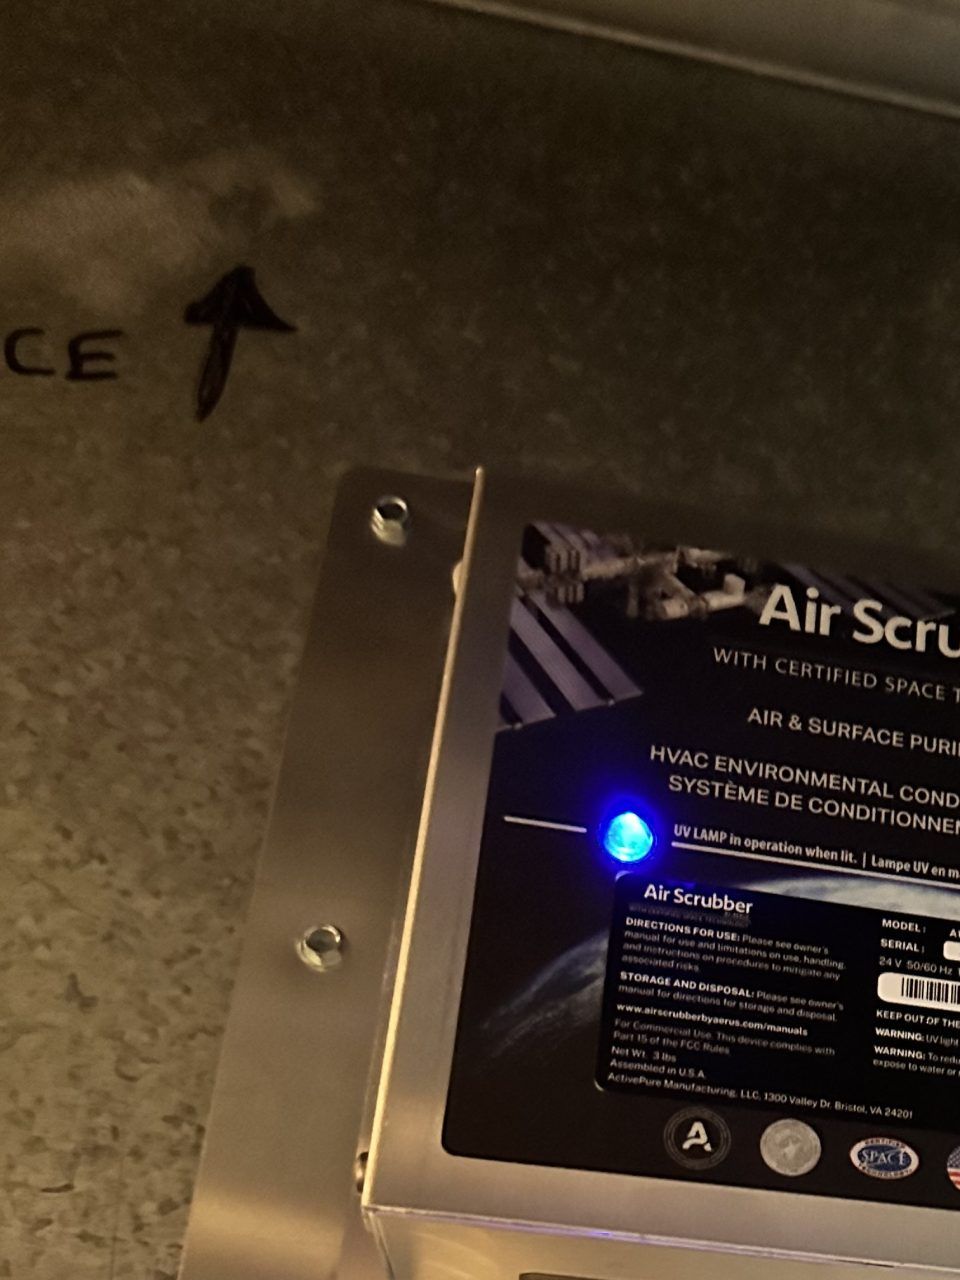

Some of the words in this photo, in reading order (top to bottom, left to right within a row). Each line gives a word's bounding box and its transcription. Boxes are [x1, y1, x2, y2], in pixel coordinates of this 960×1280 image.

[759, 585, 842, 636] Air
[712, 646, 767, 670] WITH
[774, 657, 877, 689] CERTIFIED
[884, 676, 945, 701] SPACE
[746, 706, 783, 727] AIR
[787, 713, 802, 731] &
[807, 716, 904, 748] SURFACE
[649, 744, 709, 769] HVAC
[713, 754, 894, 799] ENVIRONMENTAL
[668, 771, 770, 805] SYSTÈME
[774, 790, 803, 810] DE
[673, 823, 691, 838] UV
[692, 826, 727, 844] LAMP
[728, 832, 742, 846] in
[742, 834, 803, 858] operation
[804, 844, 838, 861] when
[840, 849, 857, 864] lit.
[870, 854, 911, 874] Lampe
[912, 860, 929, 874] UV
[930, 865, 946, 877] en
[643, 882, 671, 901] Air
[672, 887, 753, 914] Scrubber
[623, 929, 660, 942] manual
[662, 934, 676, 944] for
[677, 938, 695, 947] use
[697, 940, 716, 950] and
[716, 943, 767, 958] limitations
[768, 951, 781, 959] on
[625, 916, 691, 934] DIRECTIONS
[692, 926, 714, 938] FOR
[715, 930, 740, 942] USE:
[741, 934, 773, 947] Please
[775, 939, 792, 950] see
[622, 941, 642, 951] and
[771, 962, 781, 971] to
[823, 972, 840, 982] any
[878, 955, 892, 967] 24
[894, 958, 902, 968] V
[905, 959, 937, 973] 50/60
[938, 965, 953, 975] Hz
[617, 983, 654, 996] manual
[656, 988, 671, 998] for
[722, 997, 736, 1007] for
[776, 1005, 795, 1016] and
[619, 970, 671, 986] STORAGE
[672, 978, 697, 990] AND
[698, 982, 755, 998] DISPOSAL:
[756, 990, 788, 1003] Please
[790, 995, 806, 1006] see
[616, 1002, 808, 1036] www.airscrubberbyaerus.com/manuals
[874, 1026, 925, 1041] WARNING:
[925, 1033, 938, 1043] UV
[875, 1009, 902, 1021] KEEP
[903, 1012, 924, 1024] OUT
[925, 1016, 939, 1026] OF
[941, 1017, 960, 1029] THE
[609, 1057, 666, 1073] Assembled
[872, 1058, 906, 1070] expose
[907, 1062, 918, 1071] to
[918, 1063, 945, 1074] water
[946, 1068, 956, 1076] or
[873, 1044, 925, 1060] WARNING:
[927, 1052, 938, 1060] To
[607, 1071, 662, 1087] ActivePure
[763, 1091, 788, 1103] 1300
[788, 1095, 818, 1108] Valley
[869, 1105, 883, 1115] VA
[884, 1106, 913, 1119] 24201
